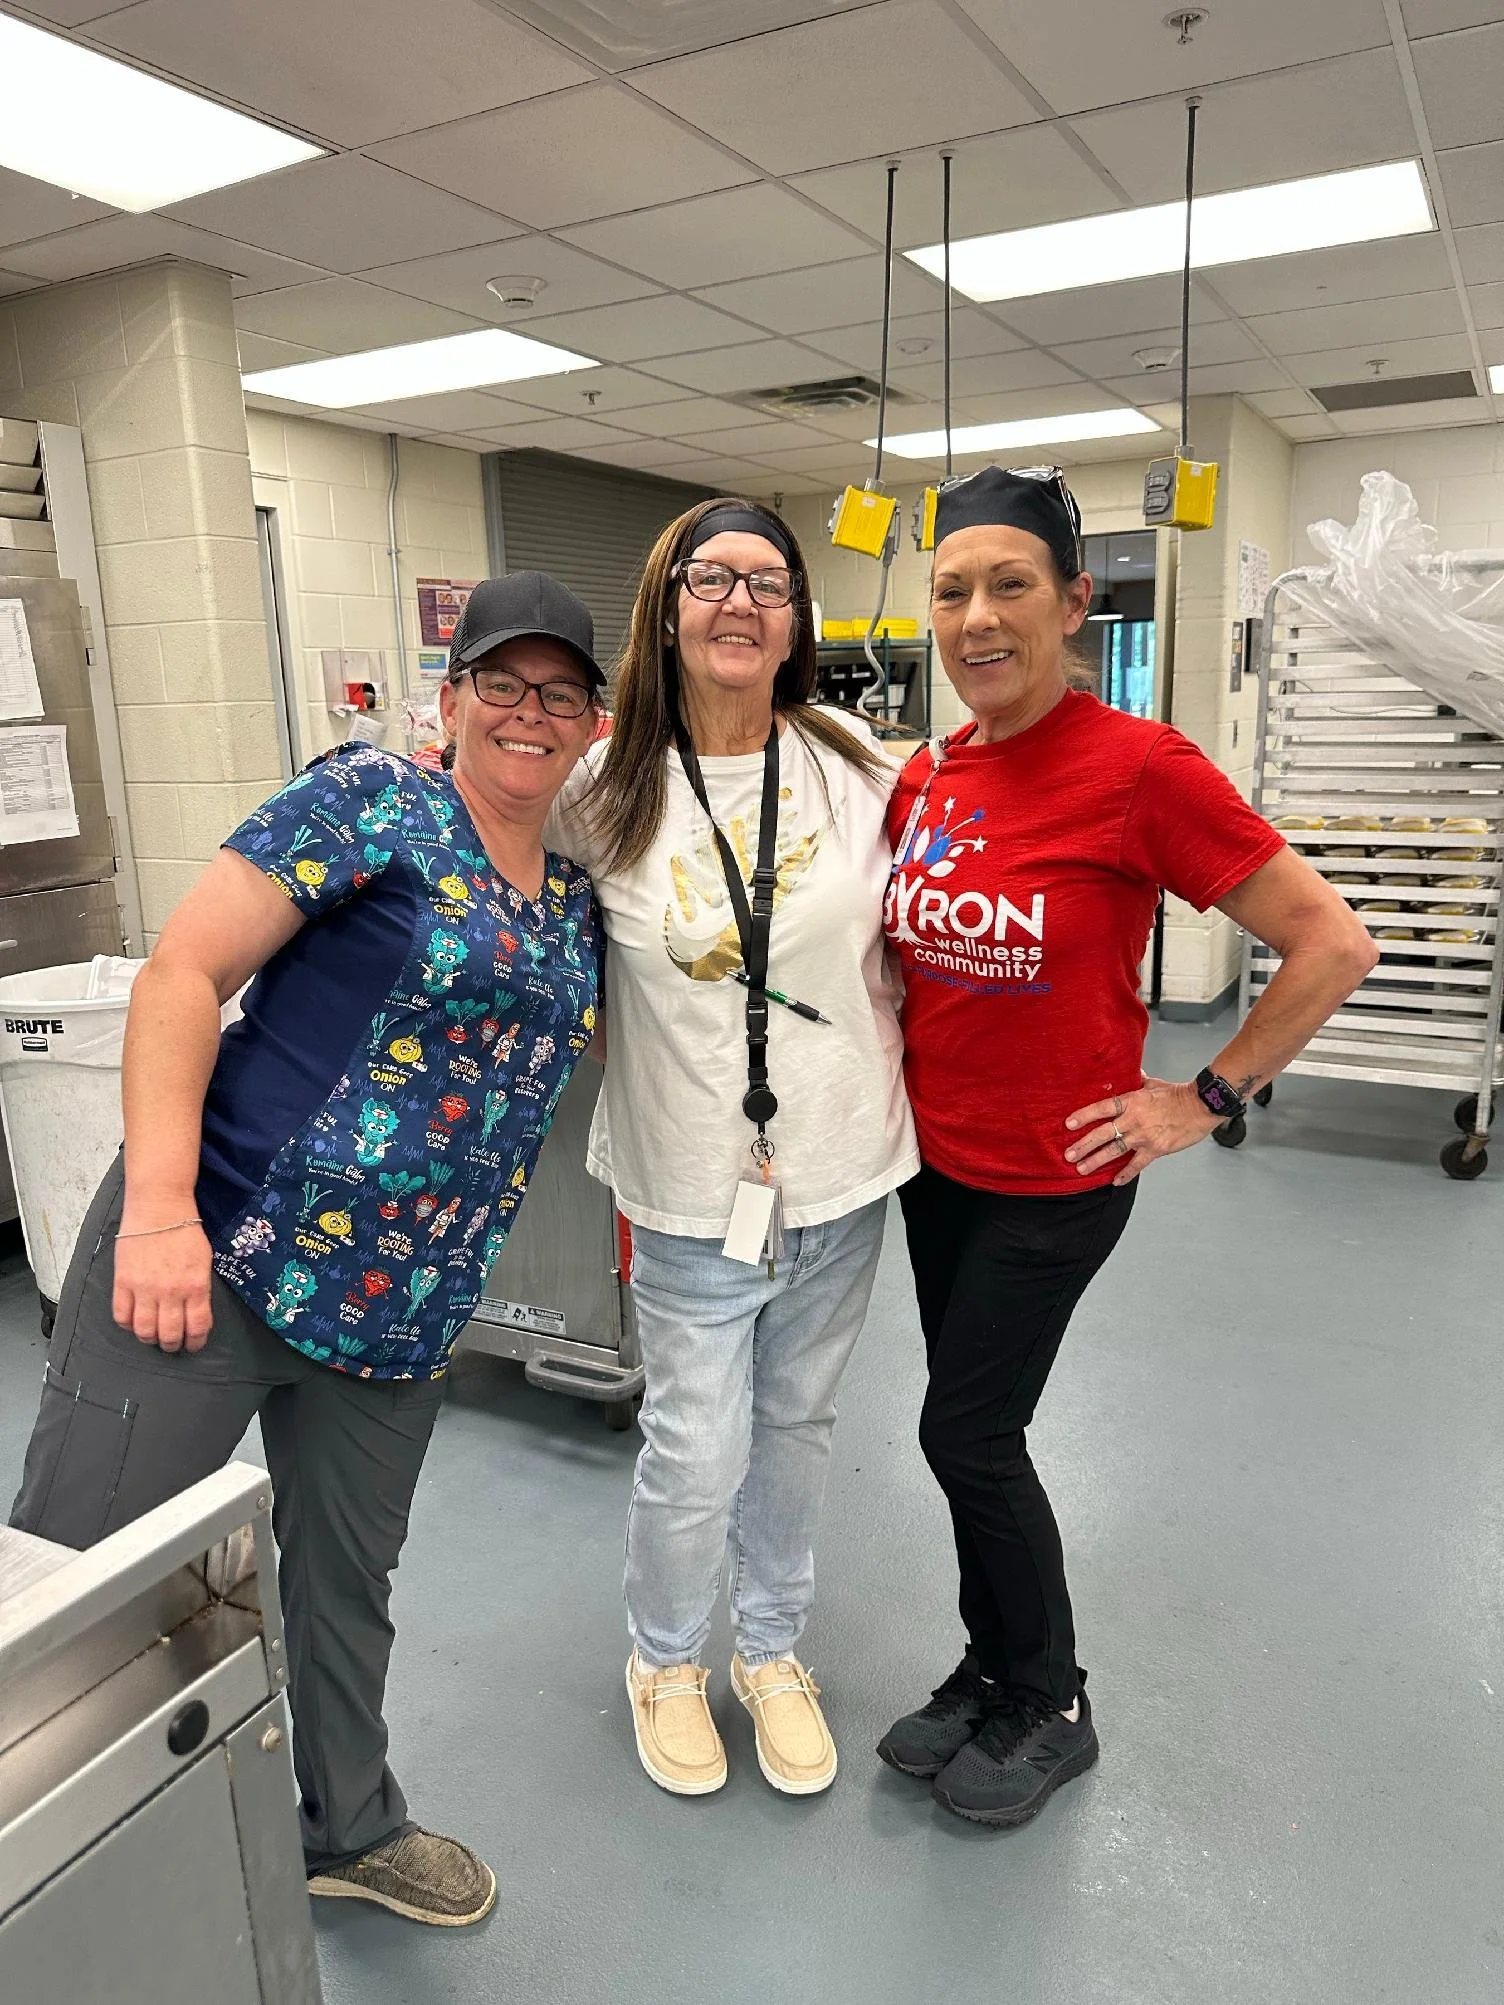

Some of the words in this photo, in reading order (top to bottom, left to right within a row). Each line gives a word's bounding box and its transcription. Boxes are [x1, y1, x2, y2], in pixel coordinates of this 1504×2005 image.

[883, 871, 1045, 942] BYRON
[935, 937, 1043, 961] wellness
[915, 948, 1042, 981] community
[1007, 983, 1052, 995] LIVES
[5, 1019, 64, 1034] BRUTE
[370, 1069, 407, 1086] Onion
[426, 1132, 450, 1144] GOOD
[295, 1235, 331, 1255] Onion
[214, 1252, 257, 1280] RAPE-FUL
[340, 1303, 364, 1318] GOOD
